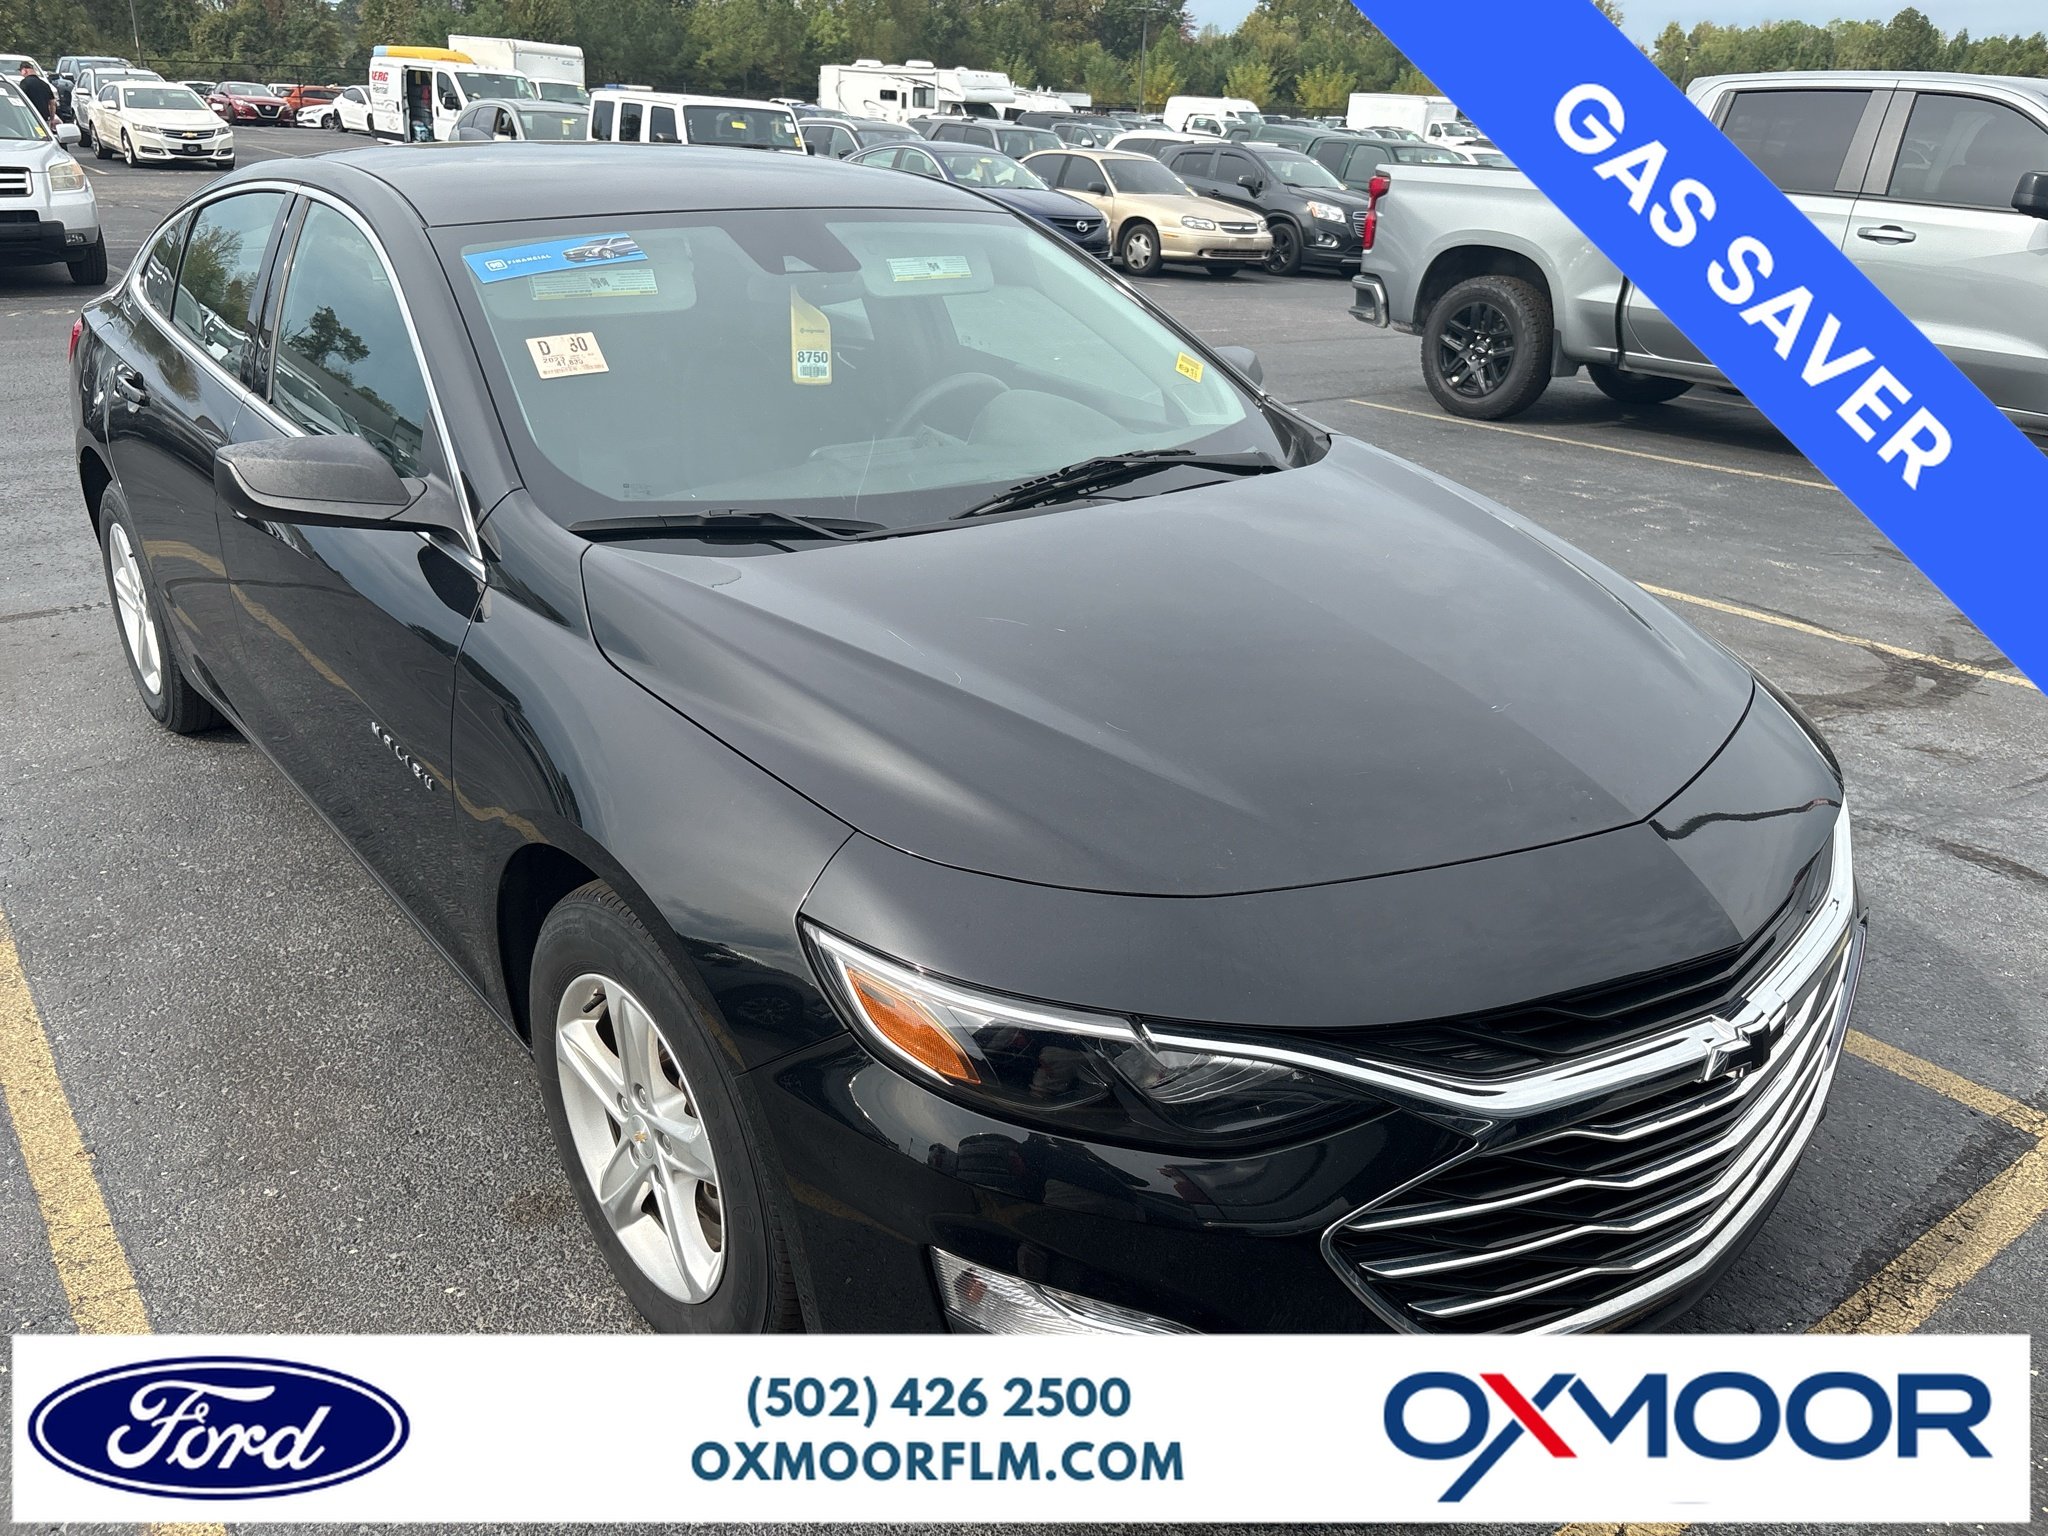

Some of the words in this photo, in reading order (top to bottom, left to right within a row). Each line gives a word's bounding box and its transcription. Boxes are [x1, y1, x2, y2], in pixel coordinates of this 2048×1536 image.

[537, 340, 551, 356] D
[797, 350, 828, 363] 8750
[371, 721, 435, 792] MALIBU
